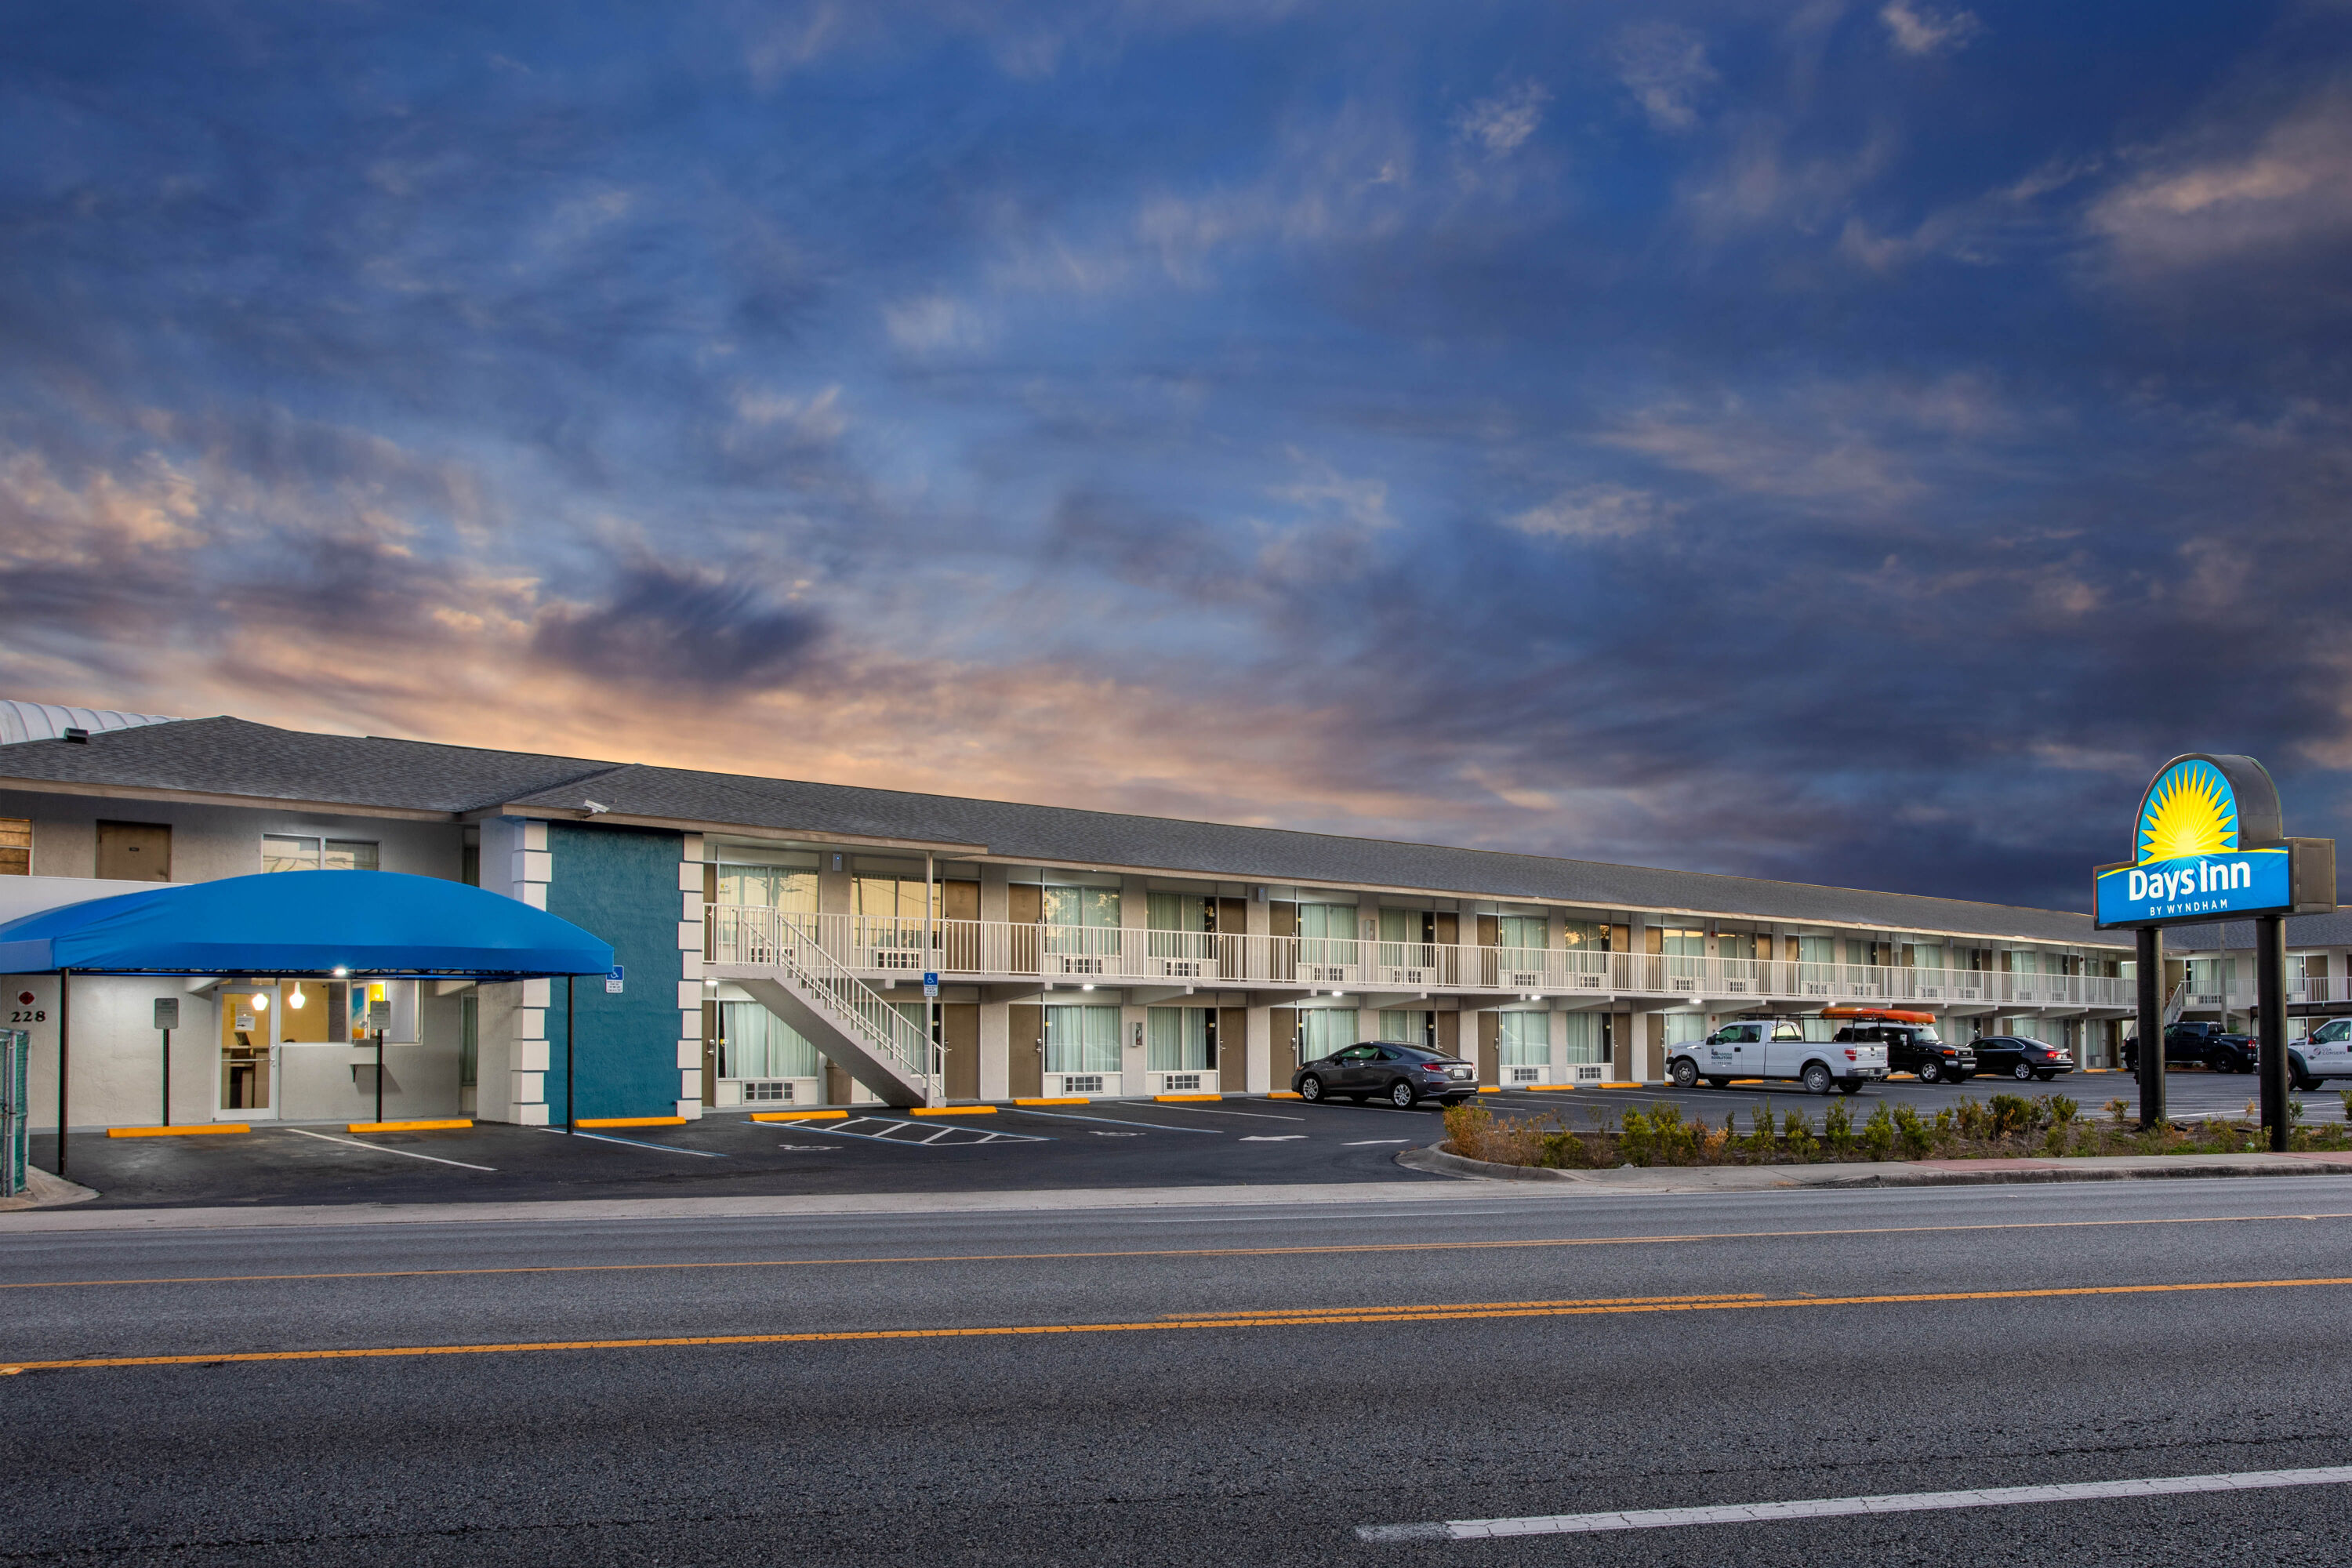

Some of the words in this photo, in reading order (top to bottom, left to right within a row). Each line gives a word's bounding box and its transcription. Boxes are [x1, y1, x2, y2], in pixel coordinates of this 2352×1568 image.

[2129, 869, 2195, 902] Days
[2200, 861, 2251, 892] Inn
[2150, 906, 2162, 916] BY
[2167, 898, 2228, 914] WYNDHAM
[11, 1011, 46, 1022] 228
